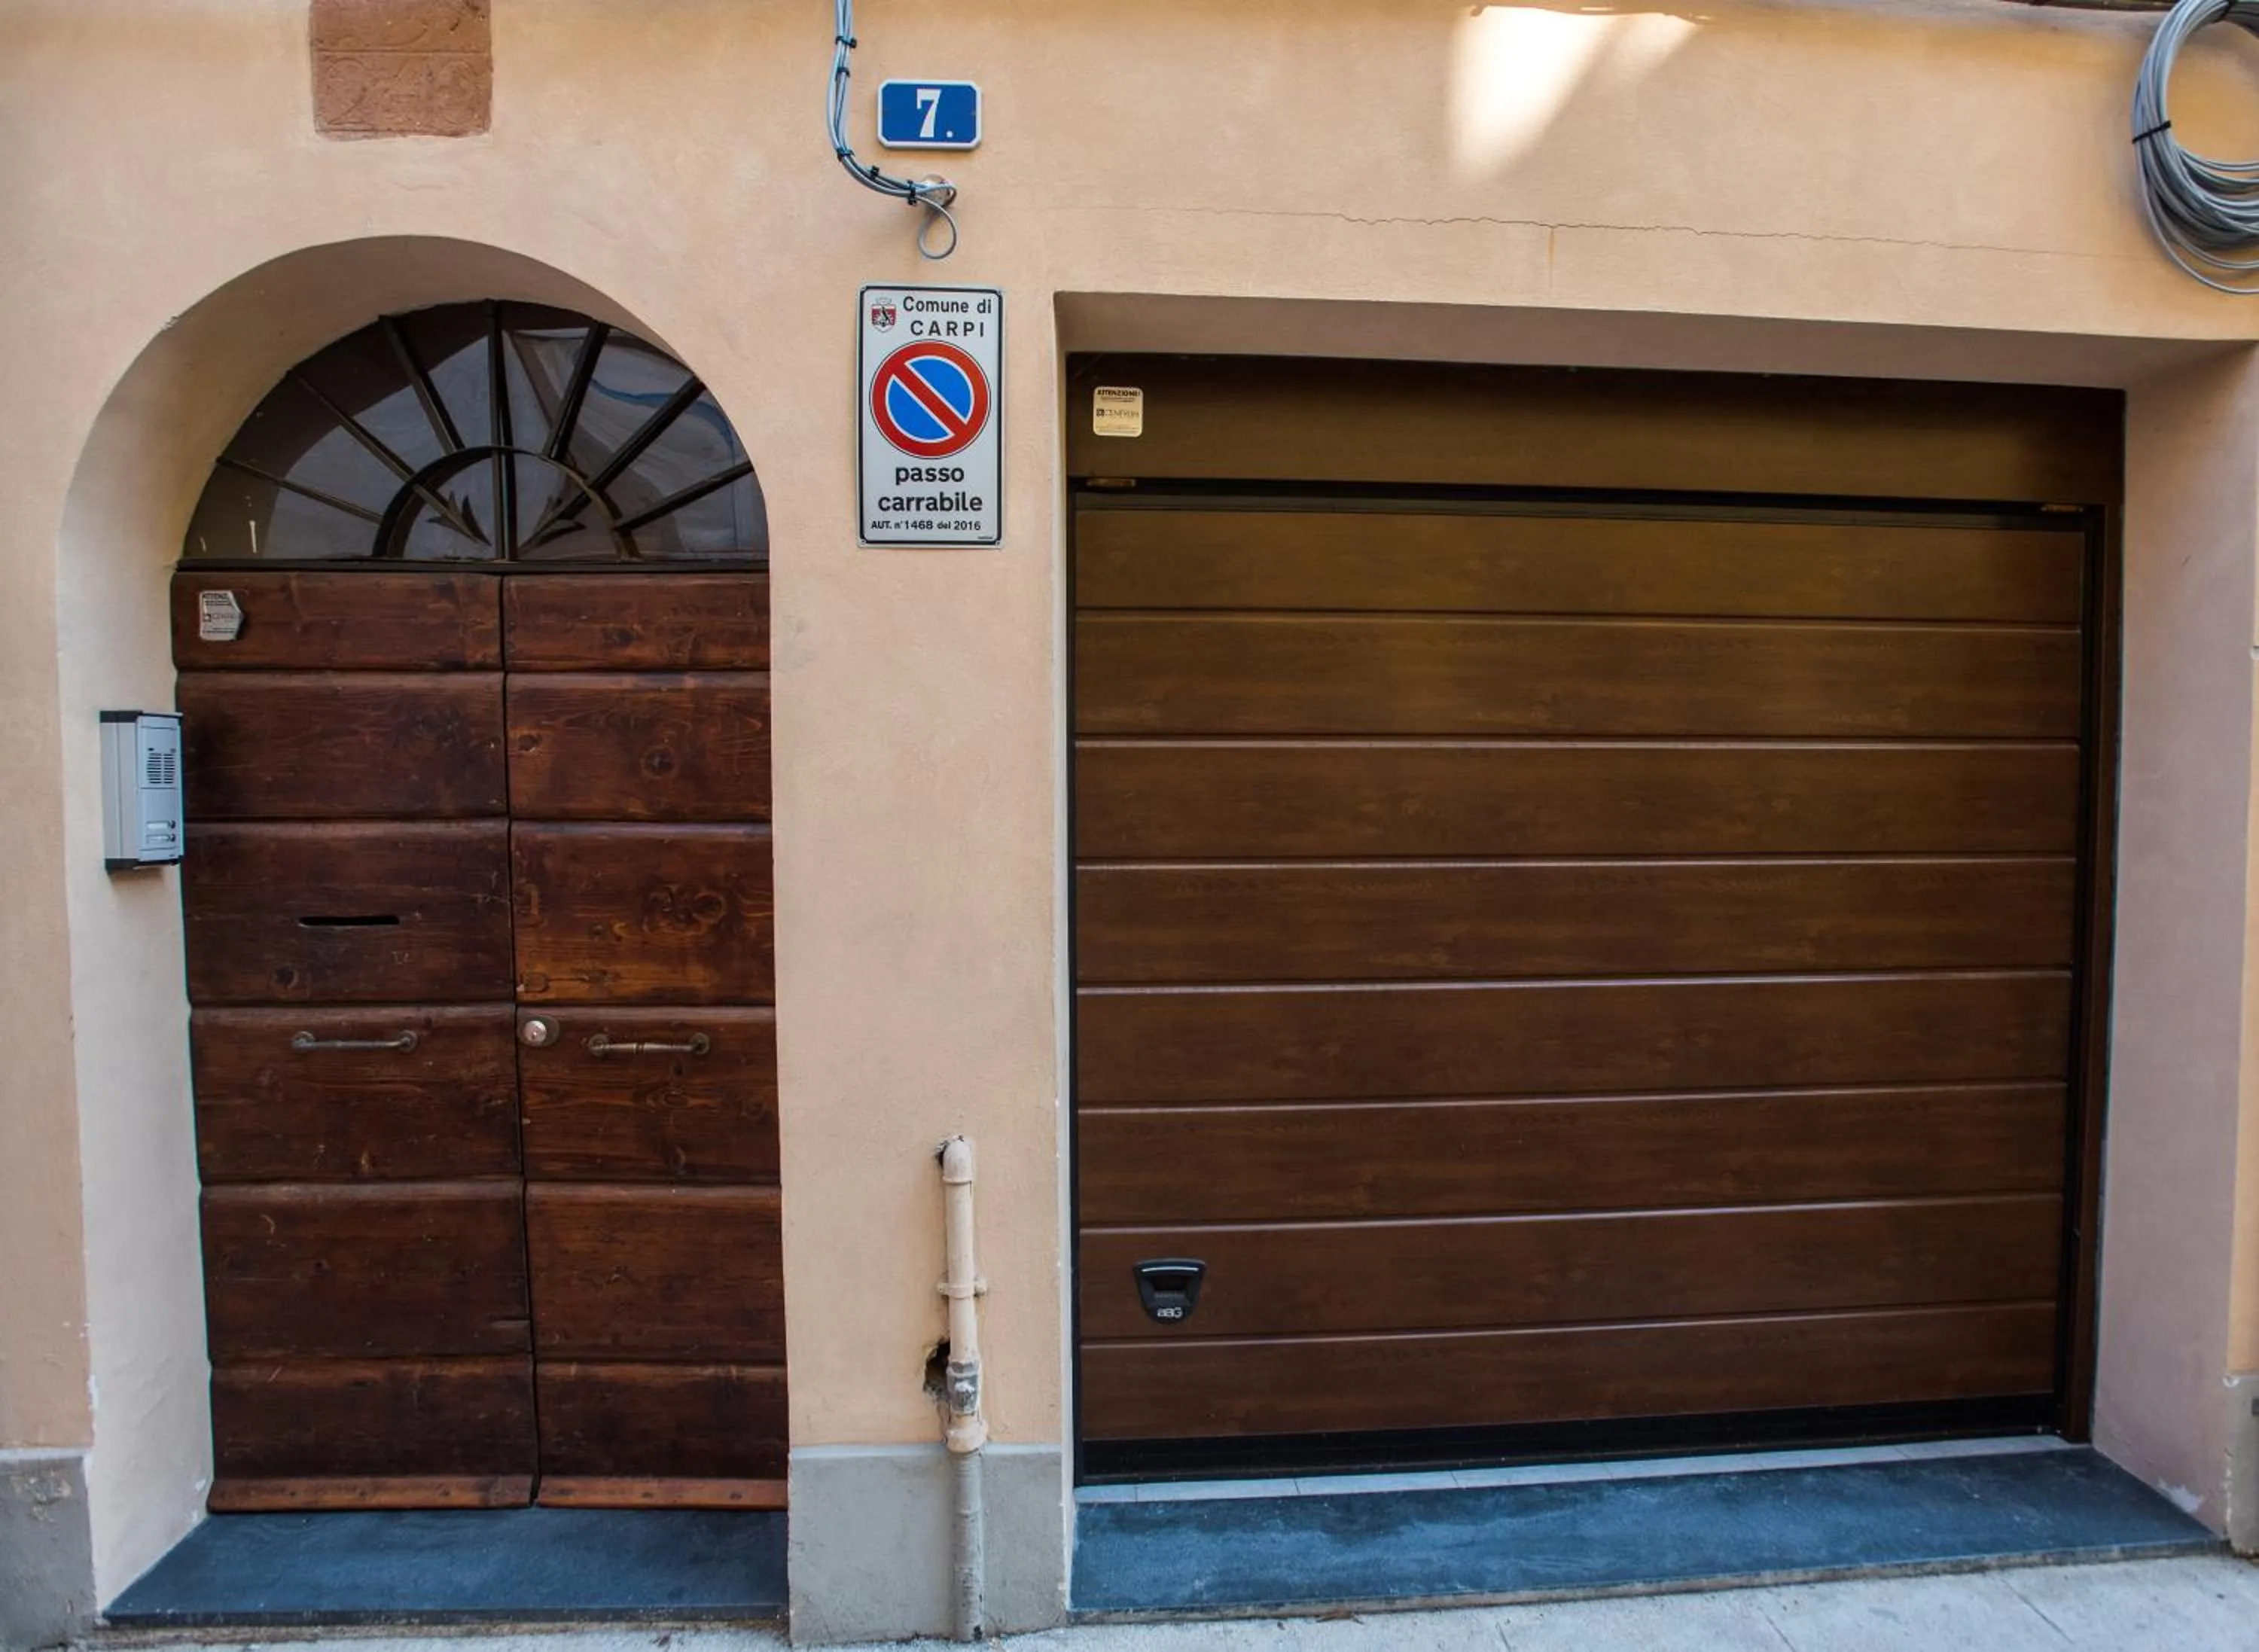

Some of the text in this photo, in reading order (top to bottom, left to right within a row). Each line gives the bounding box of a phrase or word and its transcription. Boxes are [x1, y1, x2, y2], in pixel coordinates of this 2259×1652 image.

[903, 296, 992, 314] Comune di
[910, 320, 984, 337] CARPI
[895, 467, 965, 486] passo
[878, 491, 983, 512] carrabile
[871, 520, 892, 529] AUT.
[954, 521, 981, 531] 2016
